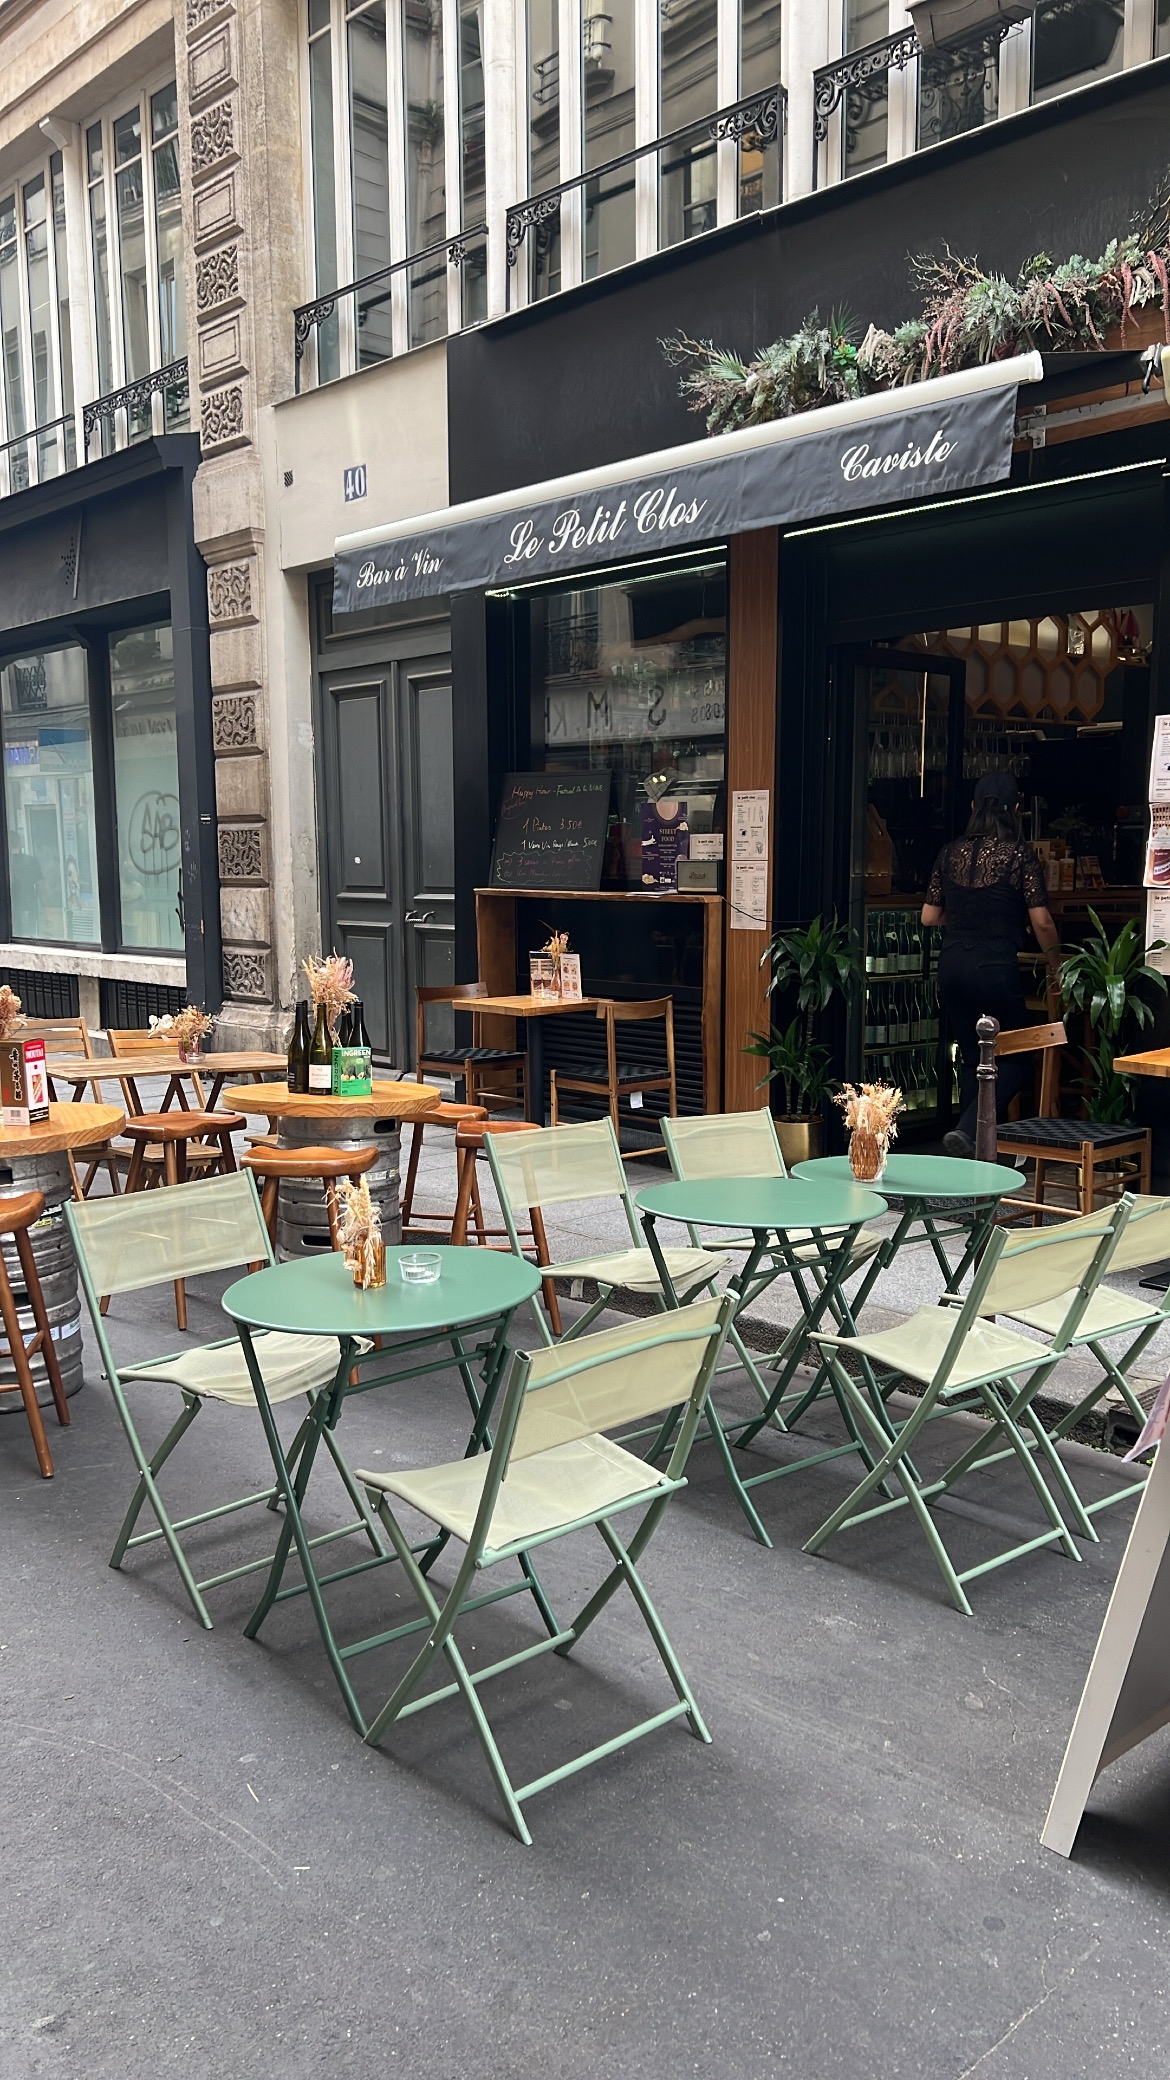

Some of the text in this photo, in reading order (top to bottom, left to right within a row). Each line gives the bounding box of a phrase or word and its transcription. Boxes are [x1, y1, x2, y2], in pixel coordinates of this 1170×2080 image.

[840, 429, 959, 482] Caviste
[346, 467, 366, 500] 40
[504, 486, 708, 564] Le Petit Clos
[356, 548, 445, 589] Bar à Vin
[511, 785, 533, 799] Happy
